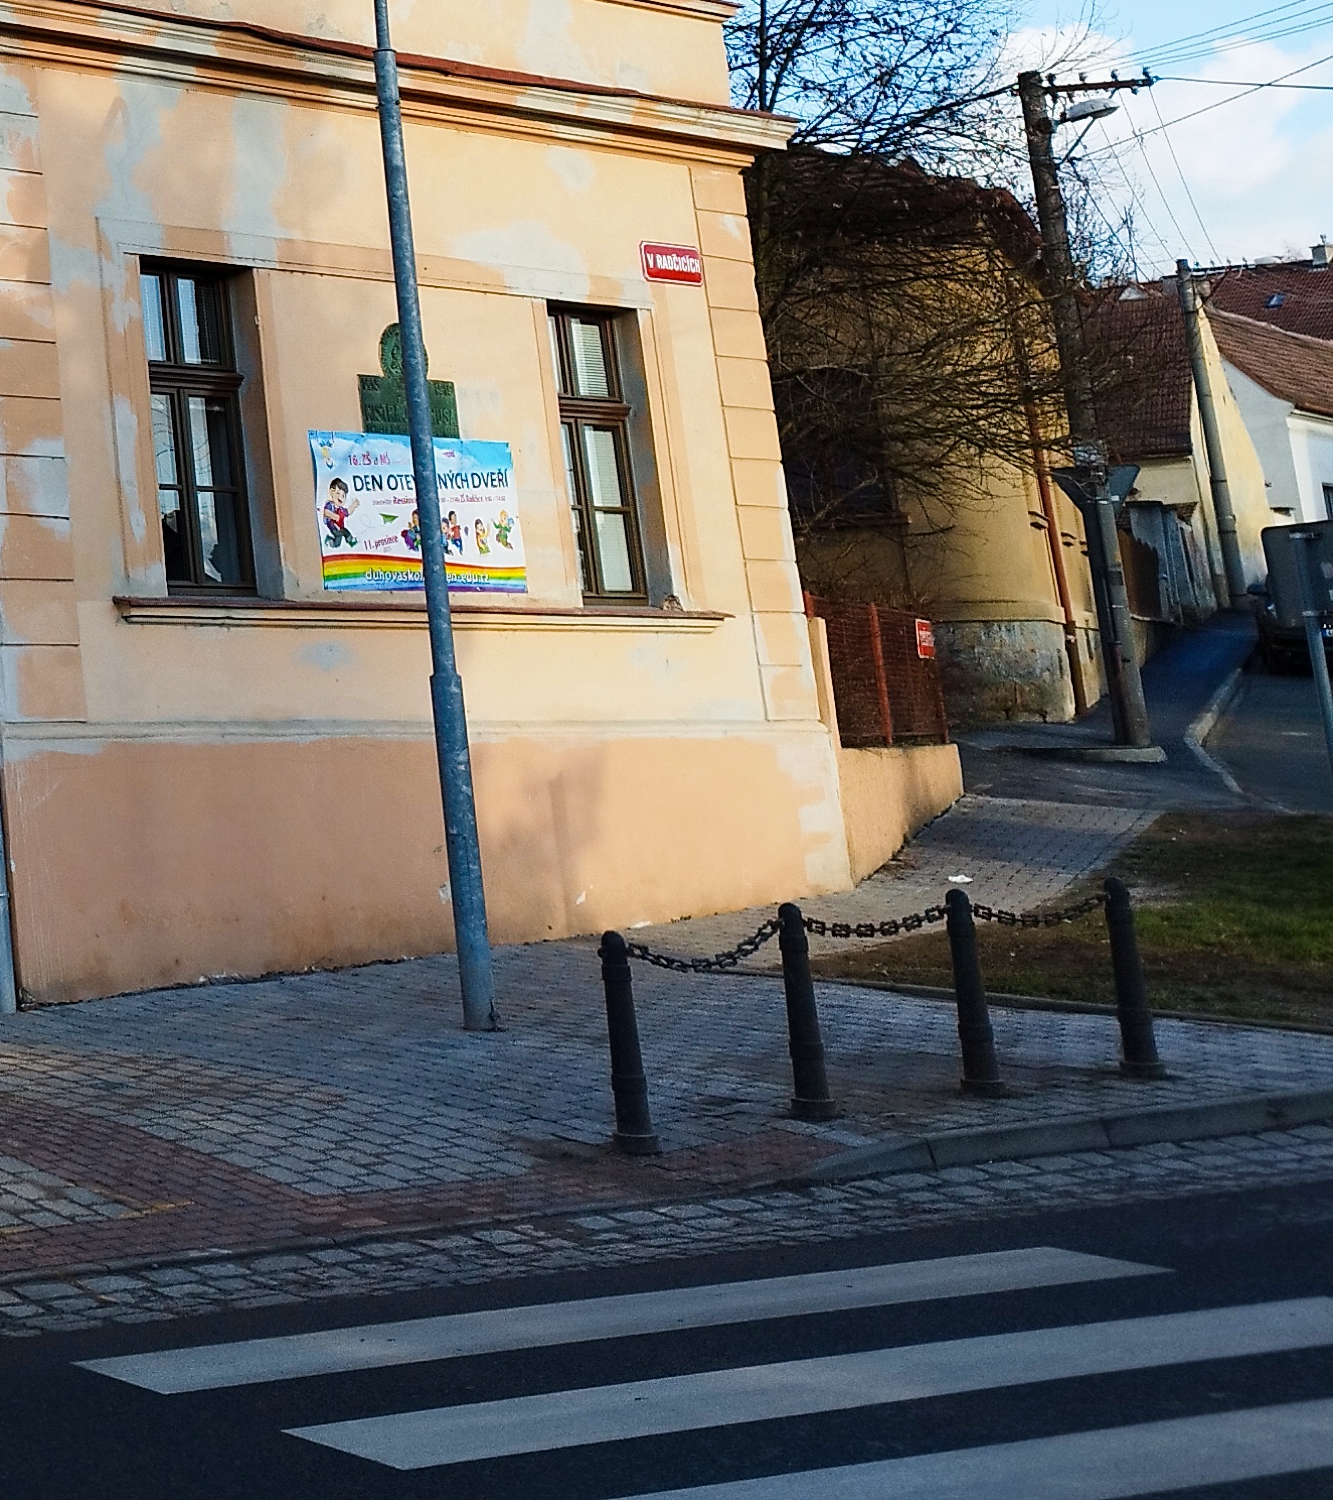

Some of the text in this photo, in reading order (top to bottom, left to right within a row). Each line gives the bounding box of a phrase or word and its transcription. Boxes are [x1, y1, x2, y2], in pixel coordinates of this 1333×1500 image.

[646, 252, 701, 273] V RADČICÍCH
[348, 453, 361, 466] 16.
[352, 474, 383, 492] DEN
[471, 467, 509, 490] DVEŘÍ
